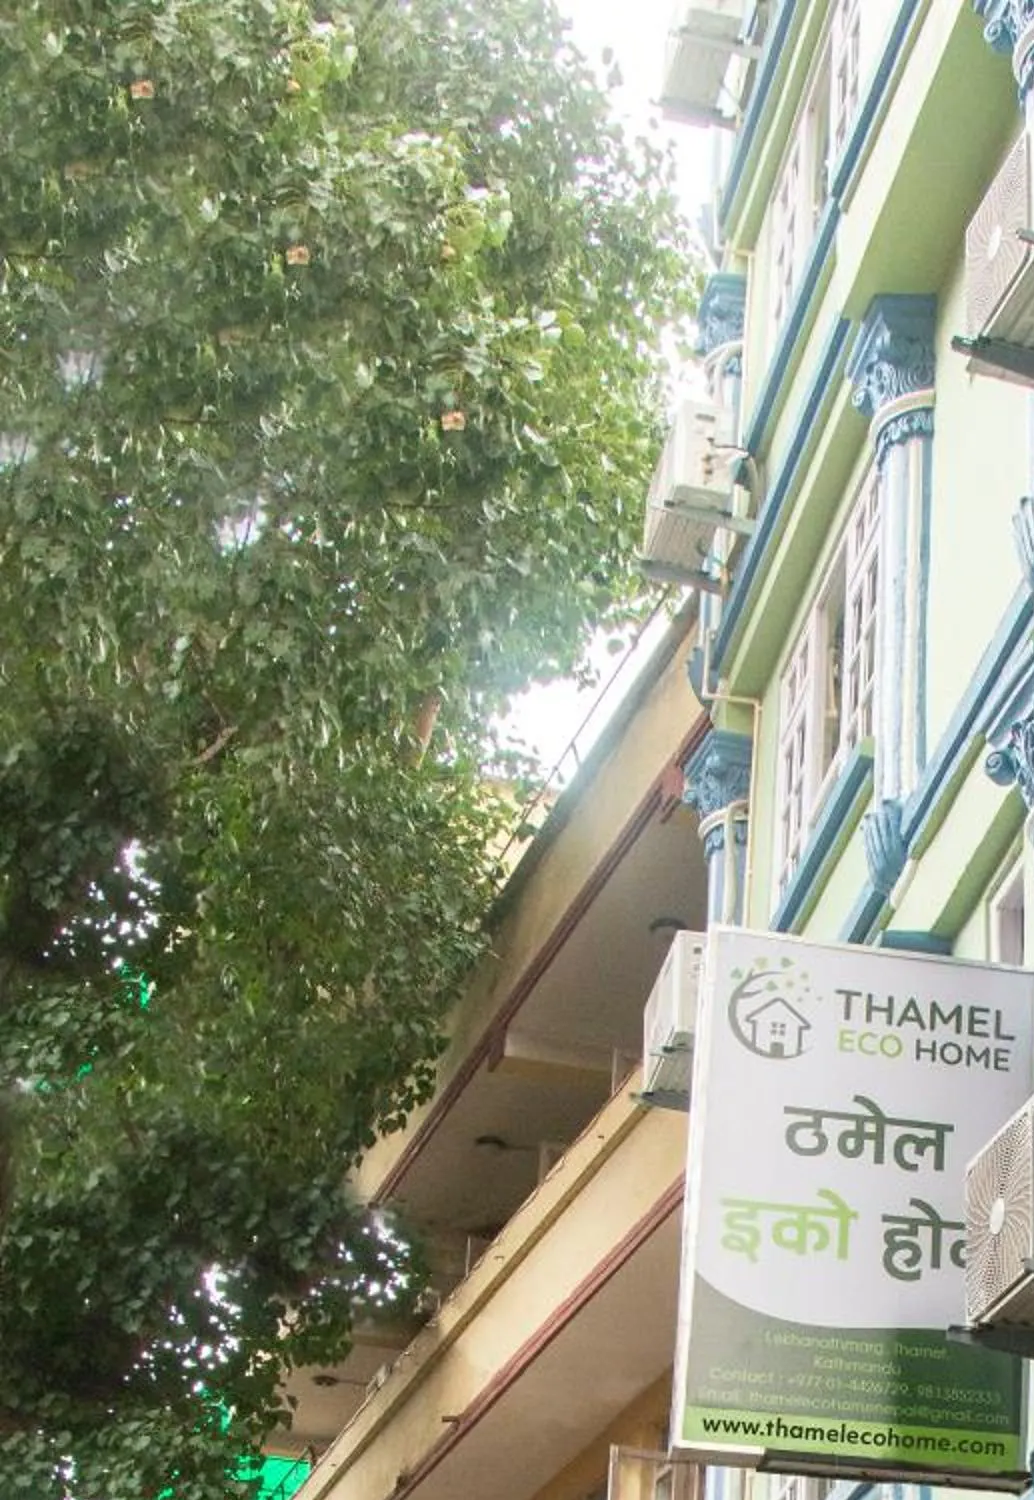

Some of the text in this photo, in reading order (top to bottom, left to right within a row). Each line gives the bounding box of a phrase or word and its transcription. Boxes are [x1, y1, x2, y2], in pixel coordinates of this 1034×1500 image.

[835, 988, 1016, 1042] THAMEL
[837, 1029, 1011, 1073] ECO HOME
[782, 1094, 955, 1172] ठमेल
[721, 1187, 859, 1263] इको
[702, 1416, 1007, 1457] www.thamelecohome.com
